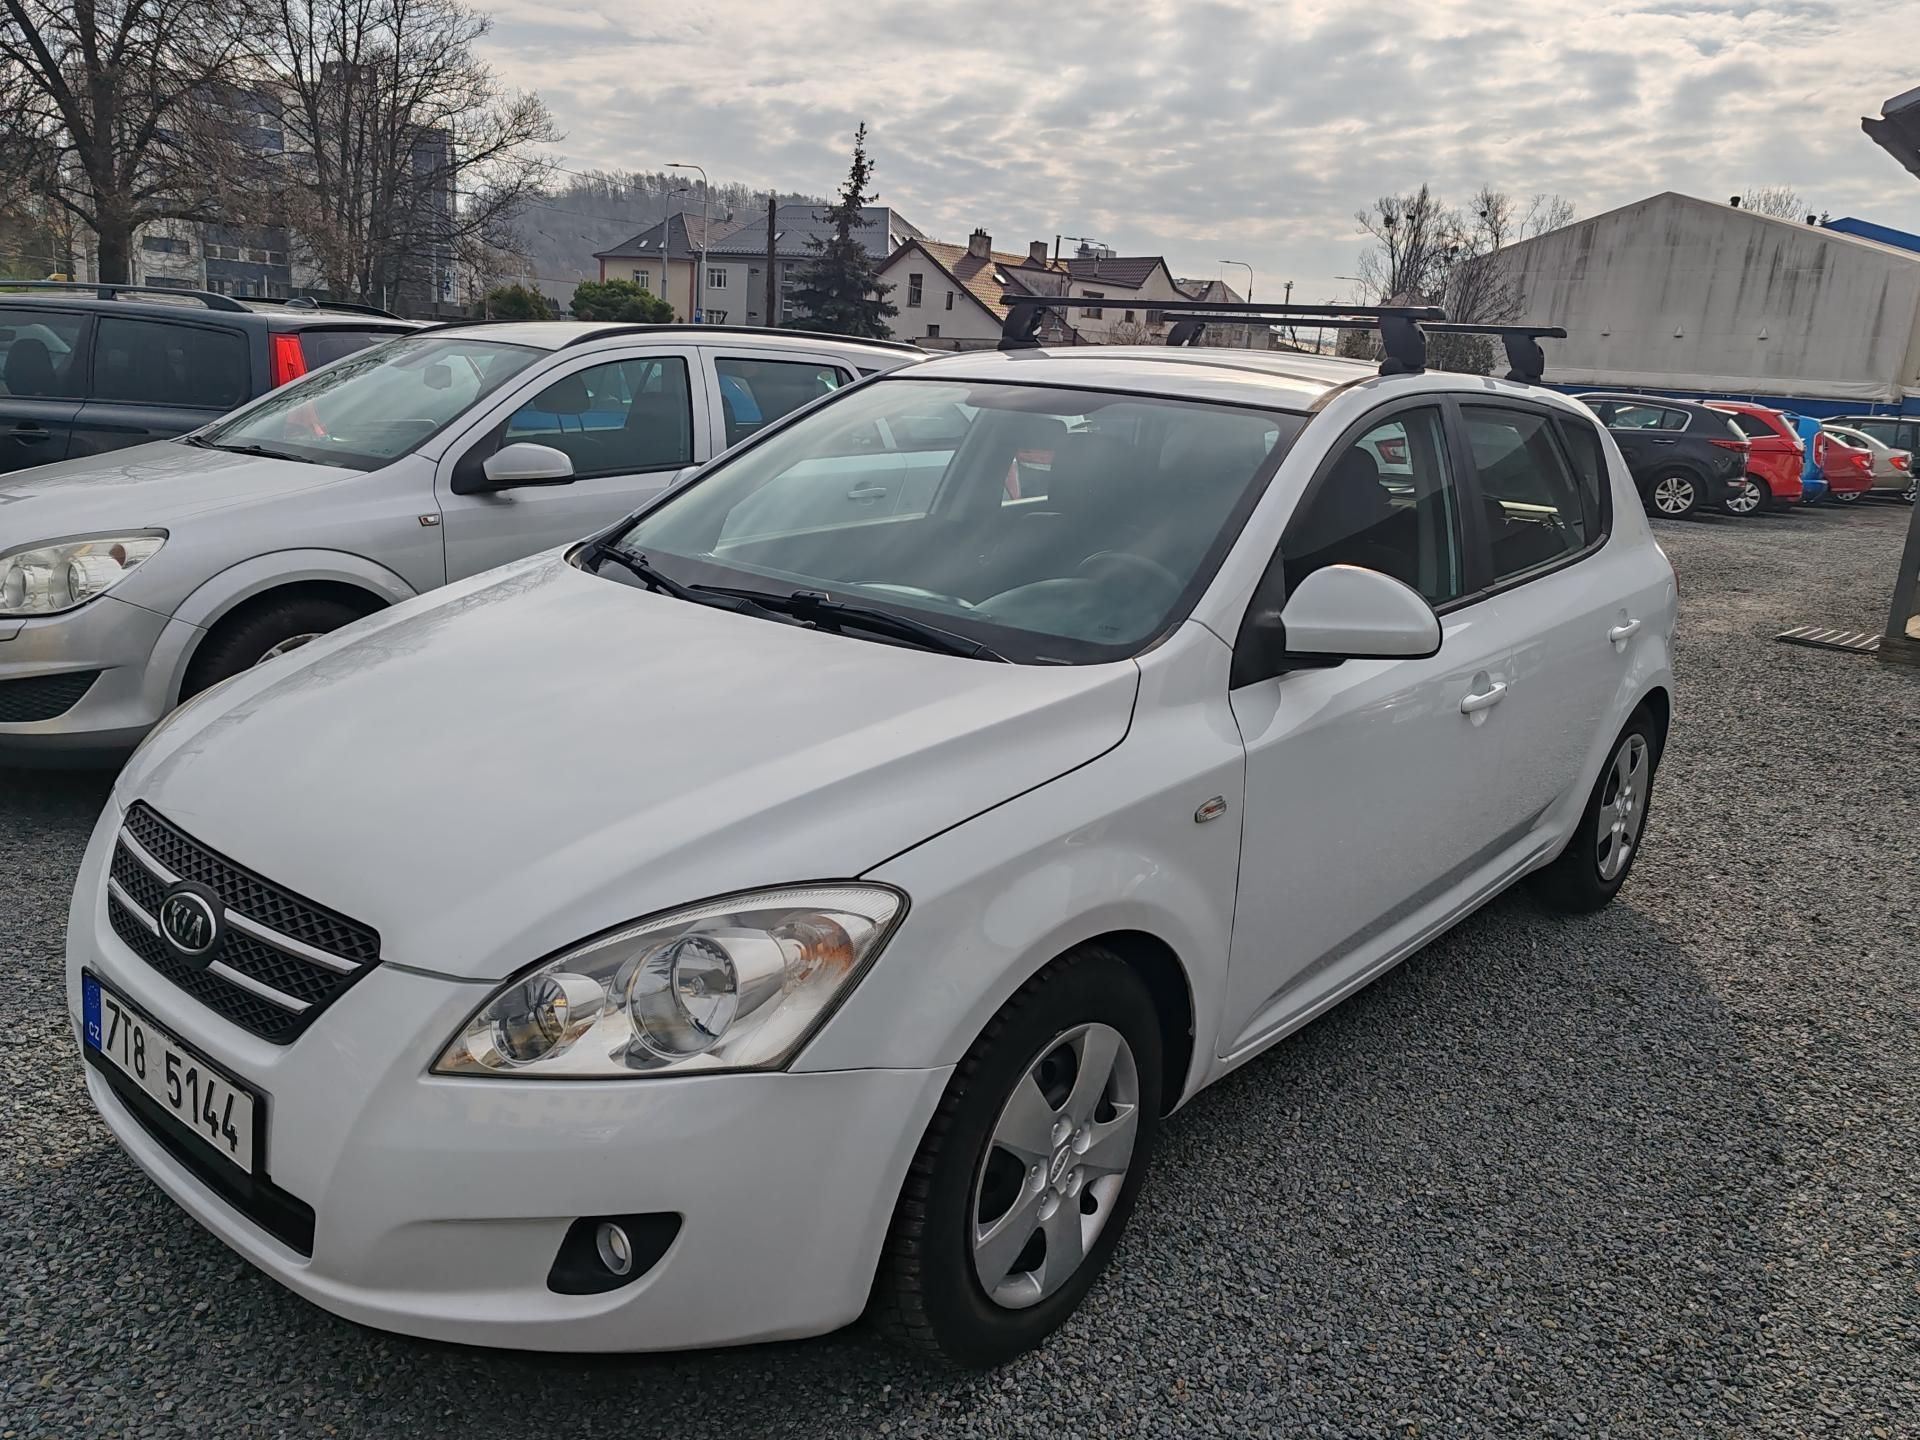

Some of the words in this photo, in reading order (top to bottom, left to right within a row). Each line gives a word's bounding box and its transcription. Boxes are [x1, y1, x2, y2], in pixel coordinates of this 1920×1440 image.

[167, 900, 204, 947] KIA
[88, 1021, 100, 1041] CZ
[106, 998, 146, 1079] 7T8
[165, 1050, 238, 1153] 5144
